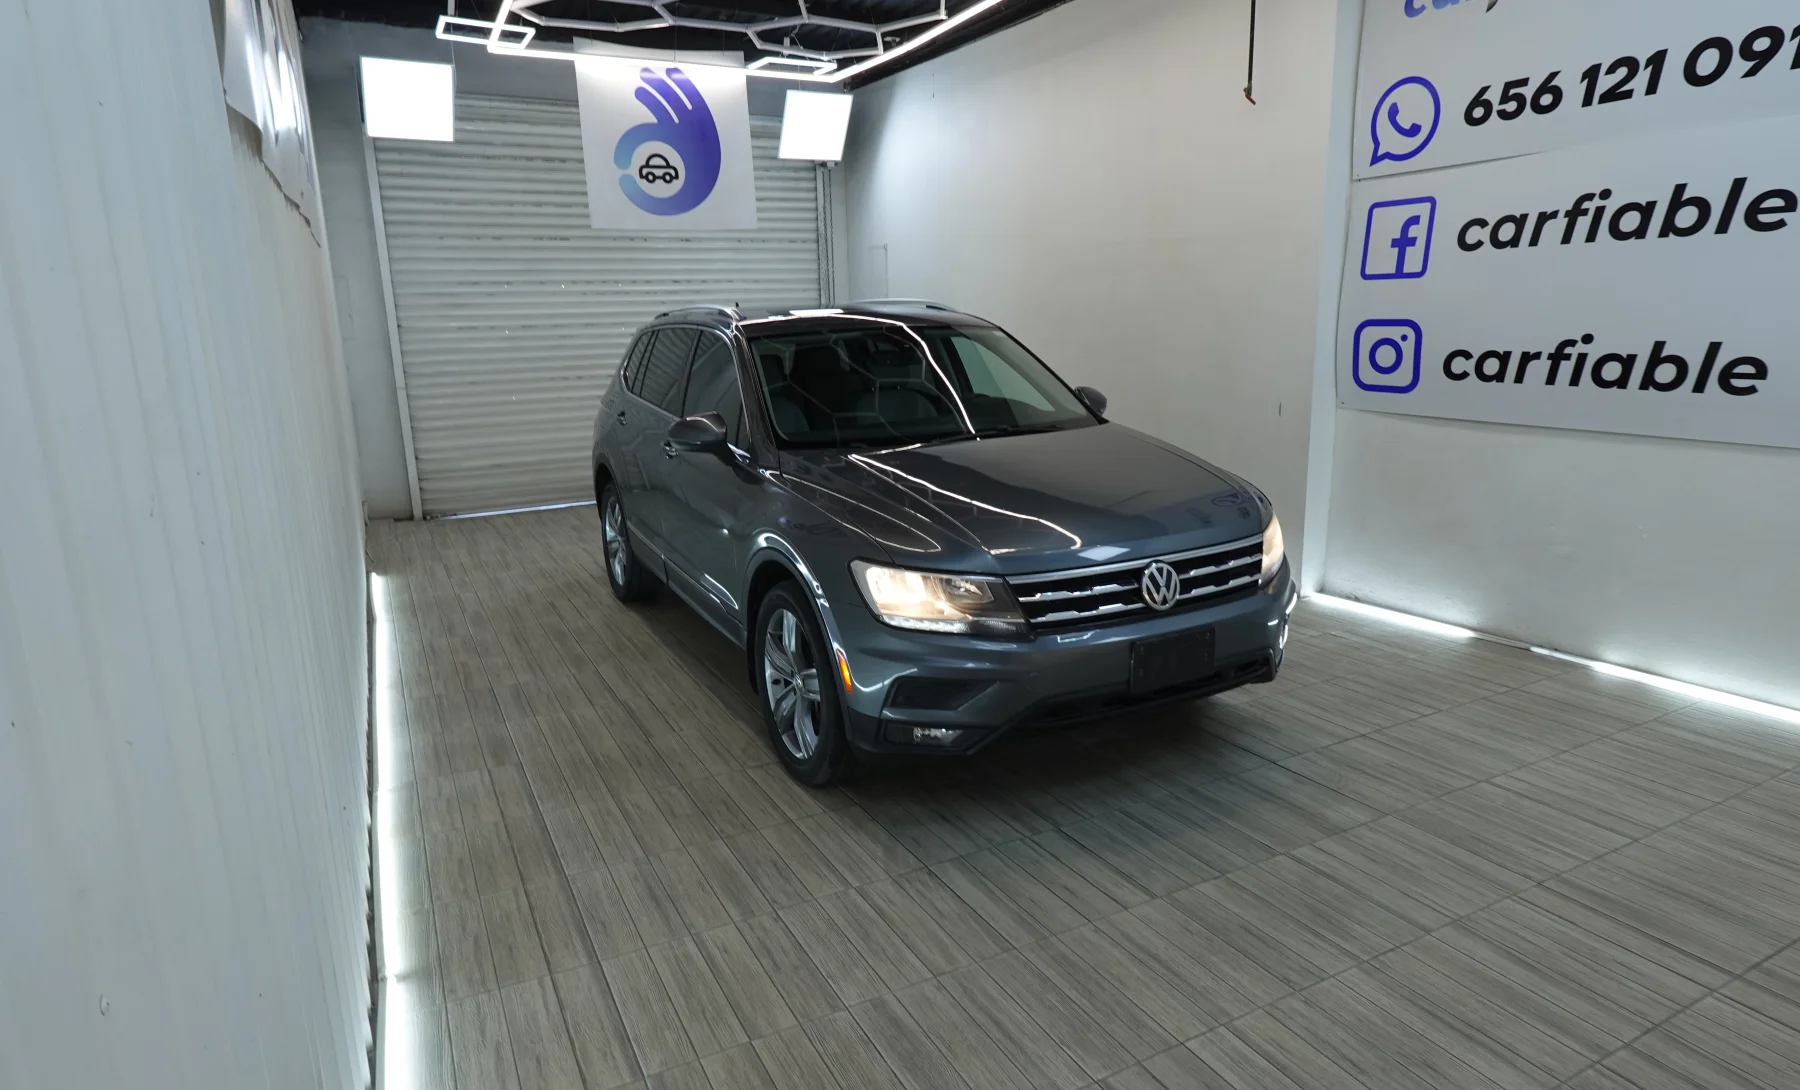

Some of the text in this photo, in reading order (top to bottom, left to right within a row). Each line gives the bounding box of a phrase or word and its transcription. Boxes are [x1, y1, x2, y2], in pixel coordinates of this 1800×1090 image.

[1463, 70, 1564, 127] 656
[1579, 48, 1669, 108] 121
[1456, 176, 1798, 252] carfiable
[1442, 333, 1769, 397] carfiable
[1142, 562, 1181, 611] VW
